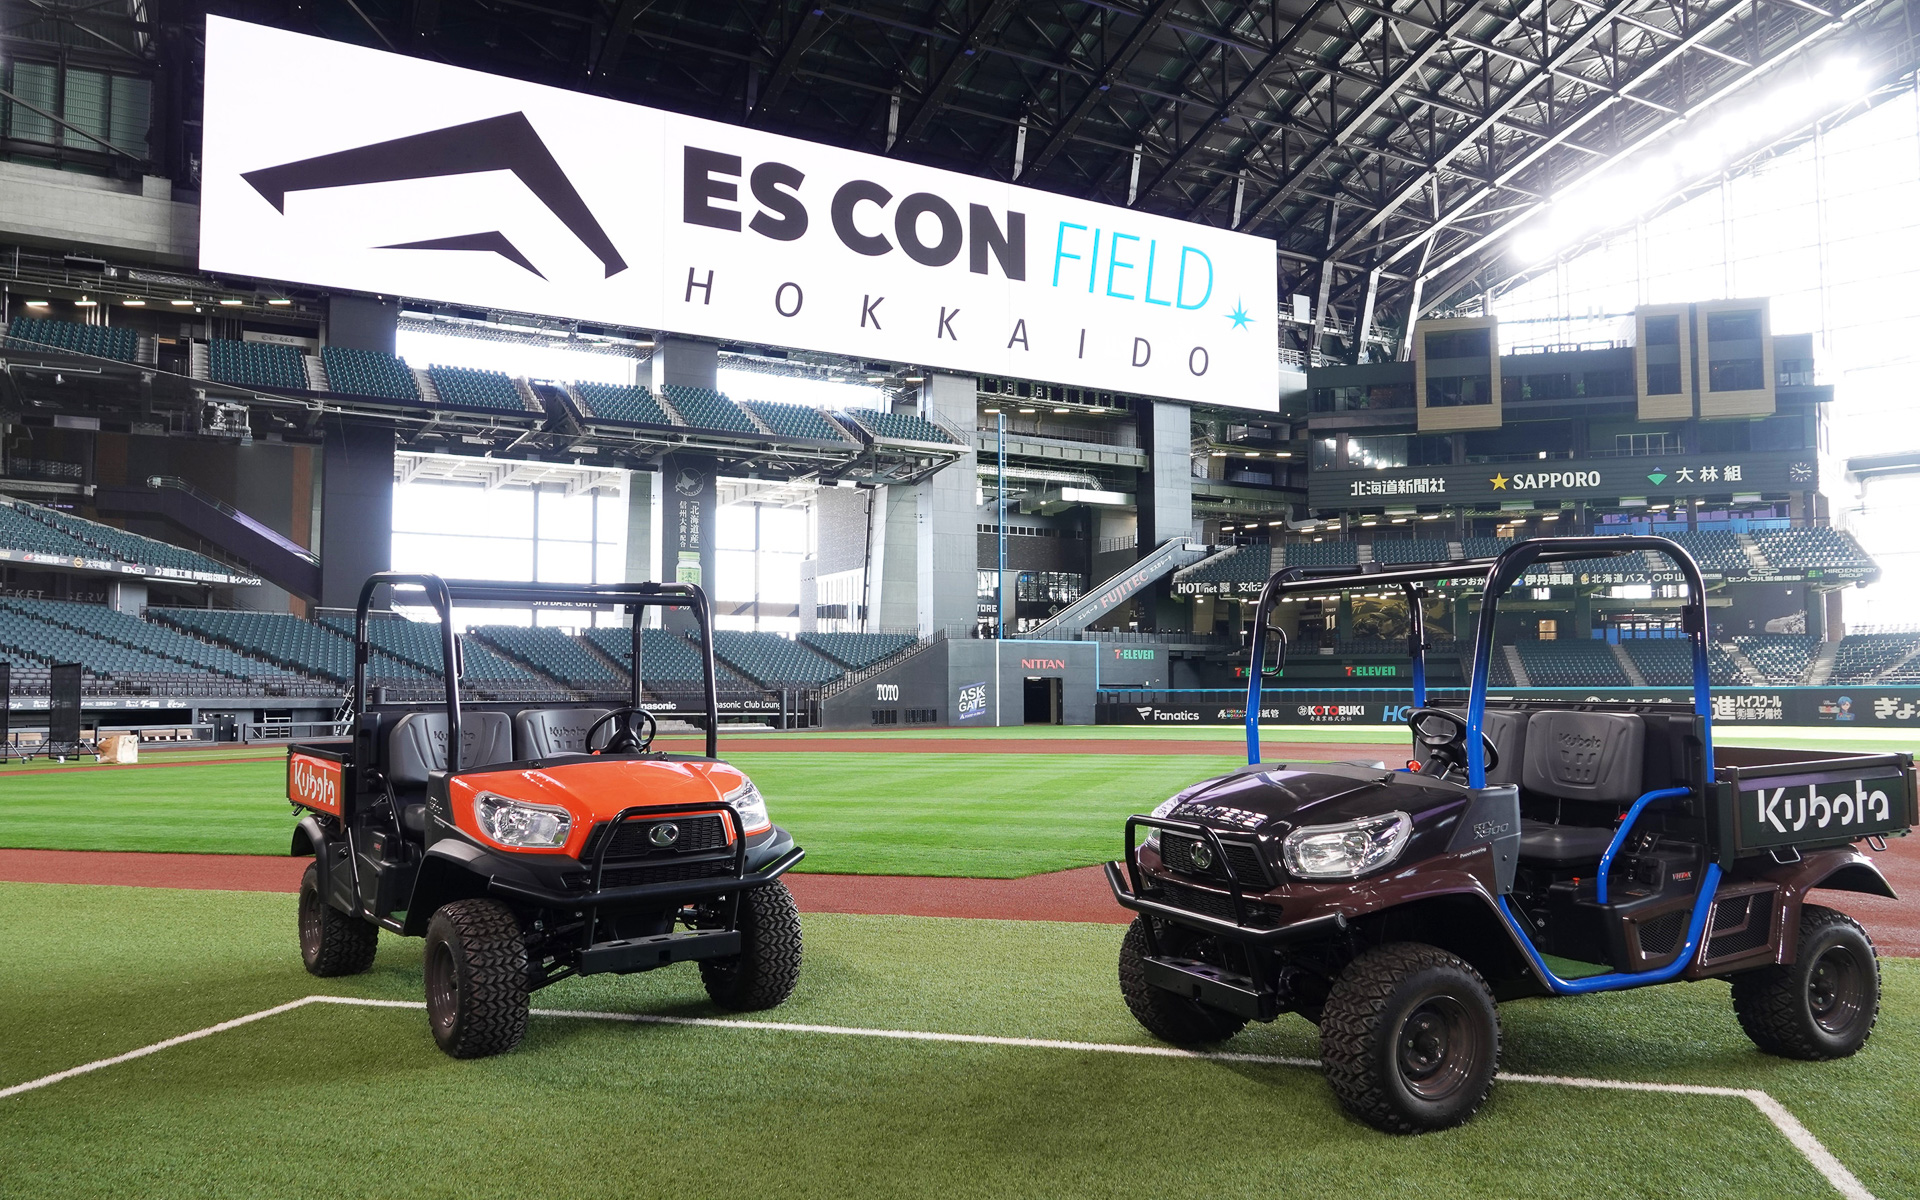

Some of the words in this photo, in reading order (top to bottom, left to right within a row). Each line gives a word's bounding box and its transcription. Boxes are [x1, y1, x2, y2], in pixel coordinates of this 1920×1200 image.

[683, 144, 809, 243] ES
[830, 178, 1026, 283] CON
[1051, 220, 1215, 313] FIELD
[683, 265, 1212, 379] HOKKAIDO
[1512, 470, 1602, 491] SAPPORO
[1675, 465, 1743, 484] 大林組
[1350, 477, 1446, 497] 北海道新聞社
[1591, 573, 1646, 584] 北海道バス
[1099, 568, 1150, 610] FUJITEC
[976, 603, 998, 614] TORE
[1021, 658, 1066, 670] NITTAN
[876, 683, 899, 702] TOTO
[1735, 695, 1782, 708] ハイスクール
[641, 700, 677, 710] nasonic
[714, 700, 742, 711] nasonic
[743, 700, 760, 709] Club
[958, 696, 986, 713] GATE
[1307, 704, 1365, 717] KOTOBUKI
[1873, 696, 1920, 721] ぎょ
[1154, 709, 1200, 721] Fanatics
[549, 725, 588, 738] Kubota
[1558, 732, 1602, 751] Kubota
[294, 760, 336, 807] Kubota
[1757, 779, 1890, 834] Kubota
